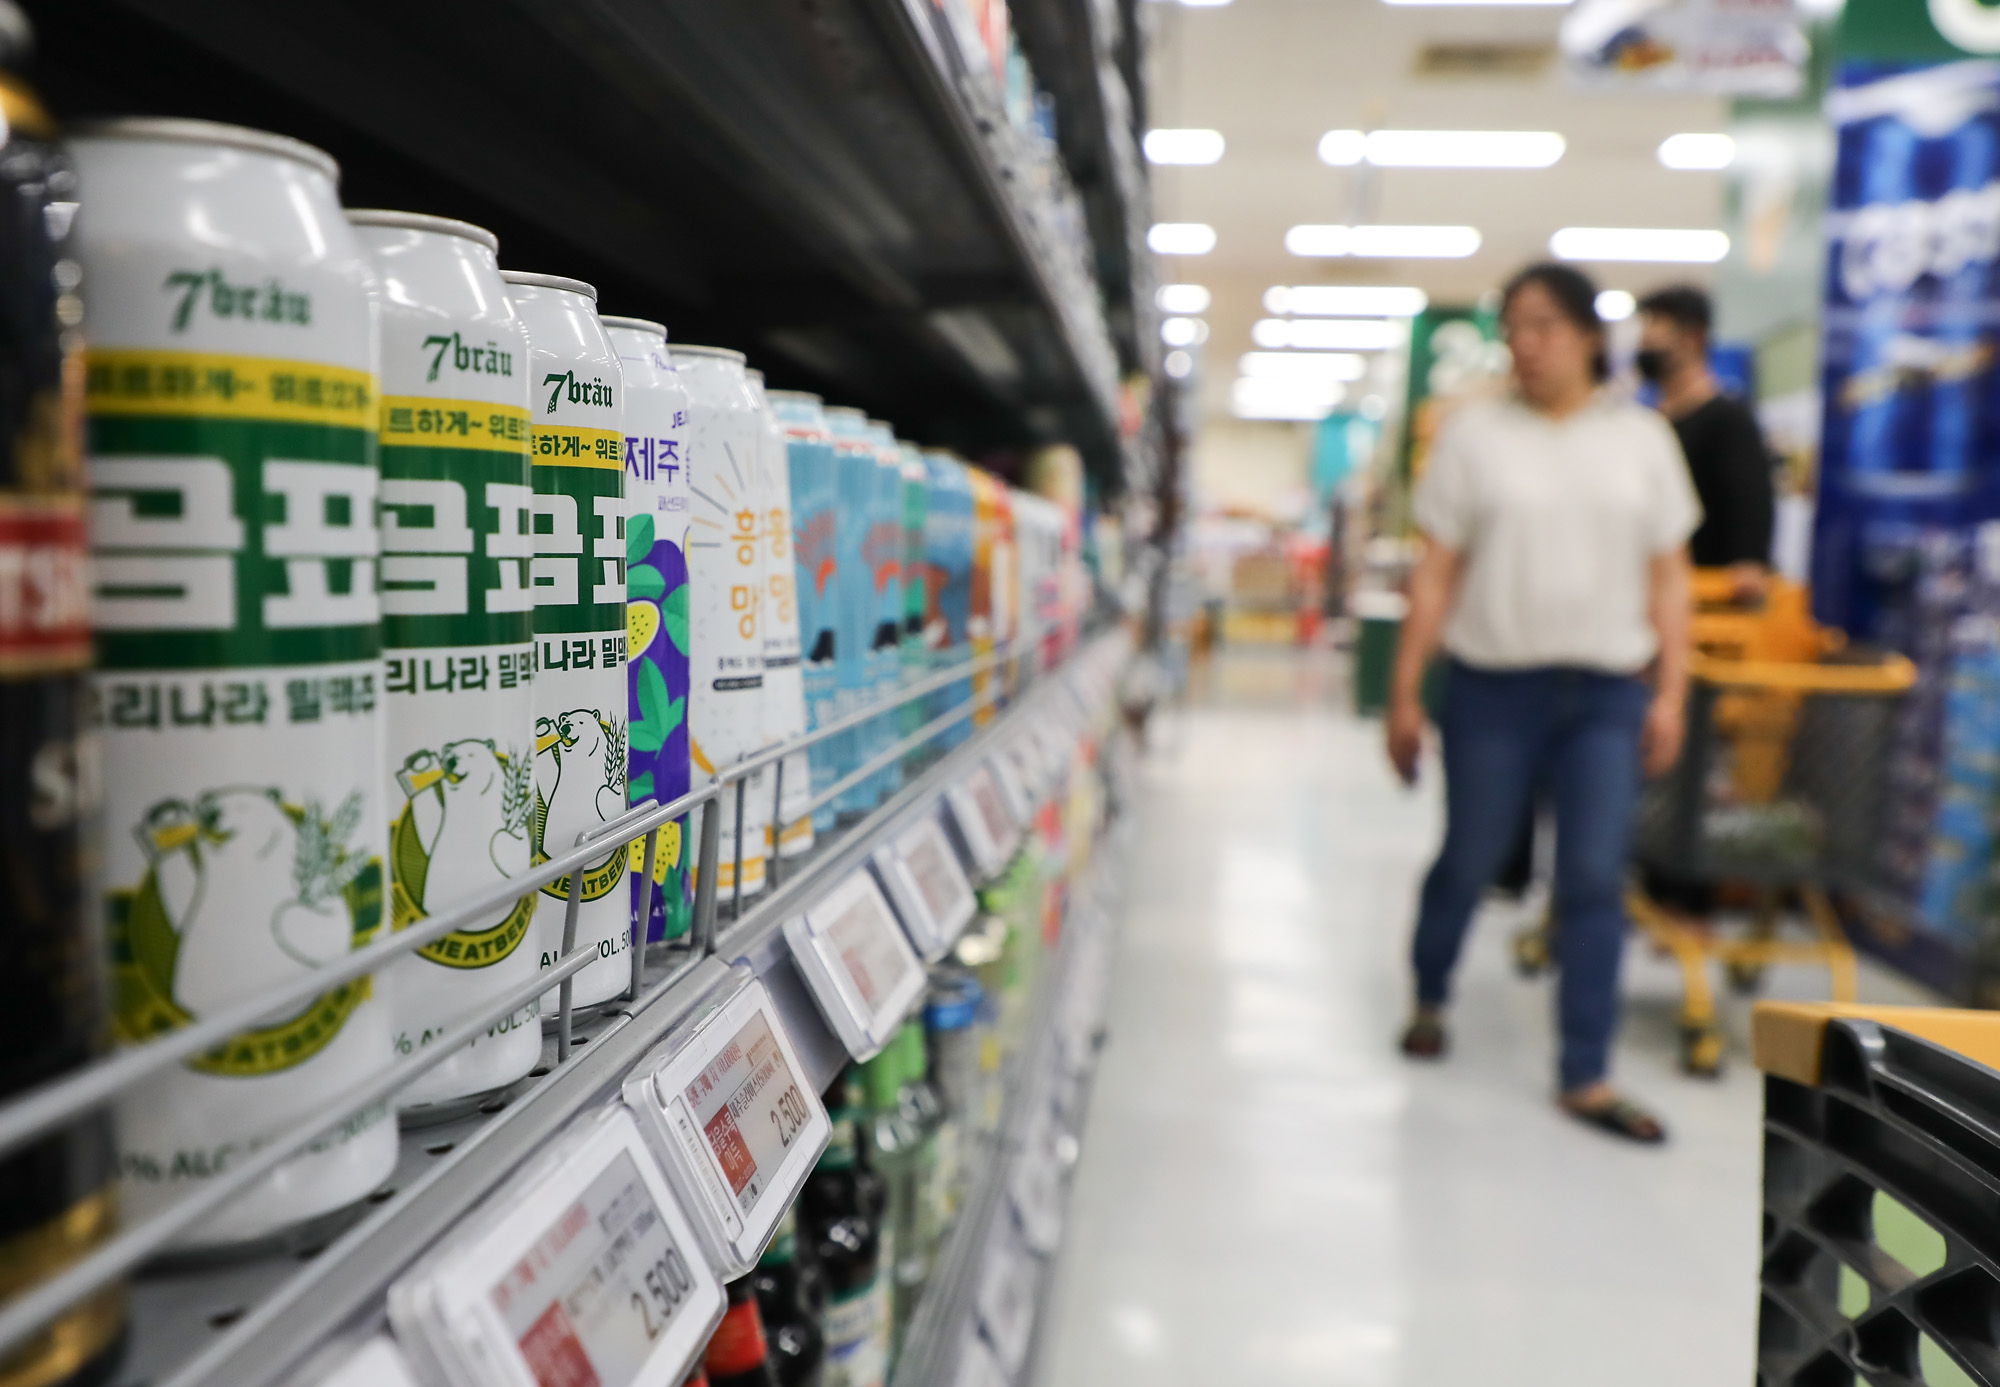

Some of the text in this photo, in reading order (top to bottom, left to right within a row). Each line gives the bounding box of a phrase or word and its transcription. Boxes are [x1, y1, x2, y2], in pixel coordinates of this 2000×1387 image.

[422, 332, 513, 383] 7bräu
[543, 370, 613, 414] 7bräu
[90, 674, 269, 730] 리나라
[770, 1084, 807, 1148] 2,500
[631, 1247, 690, 1342] 2,500
